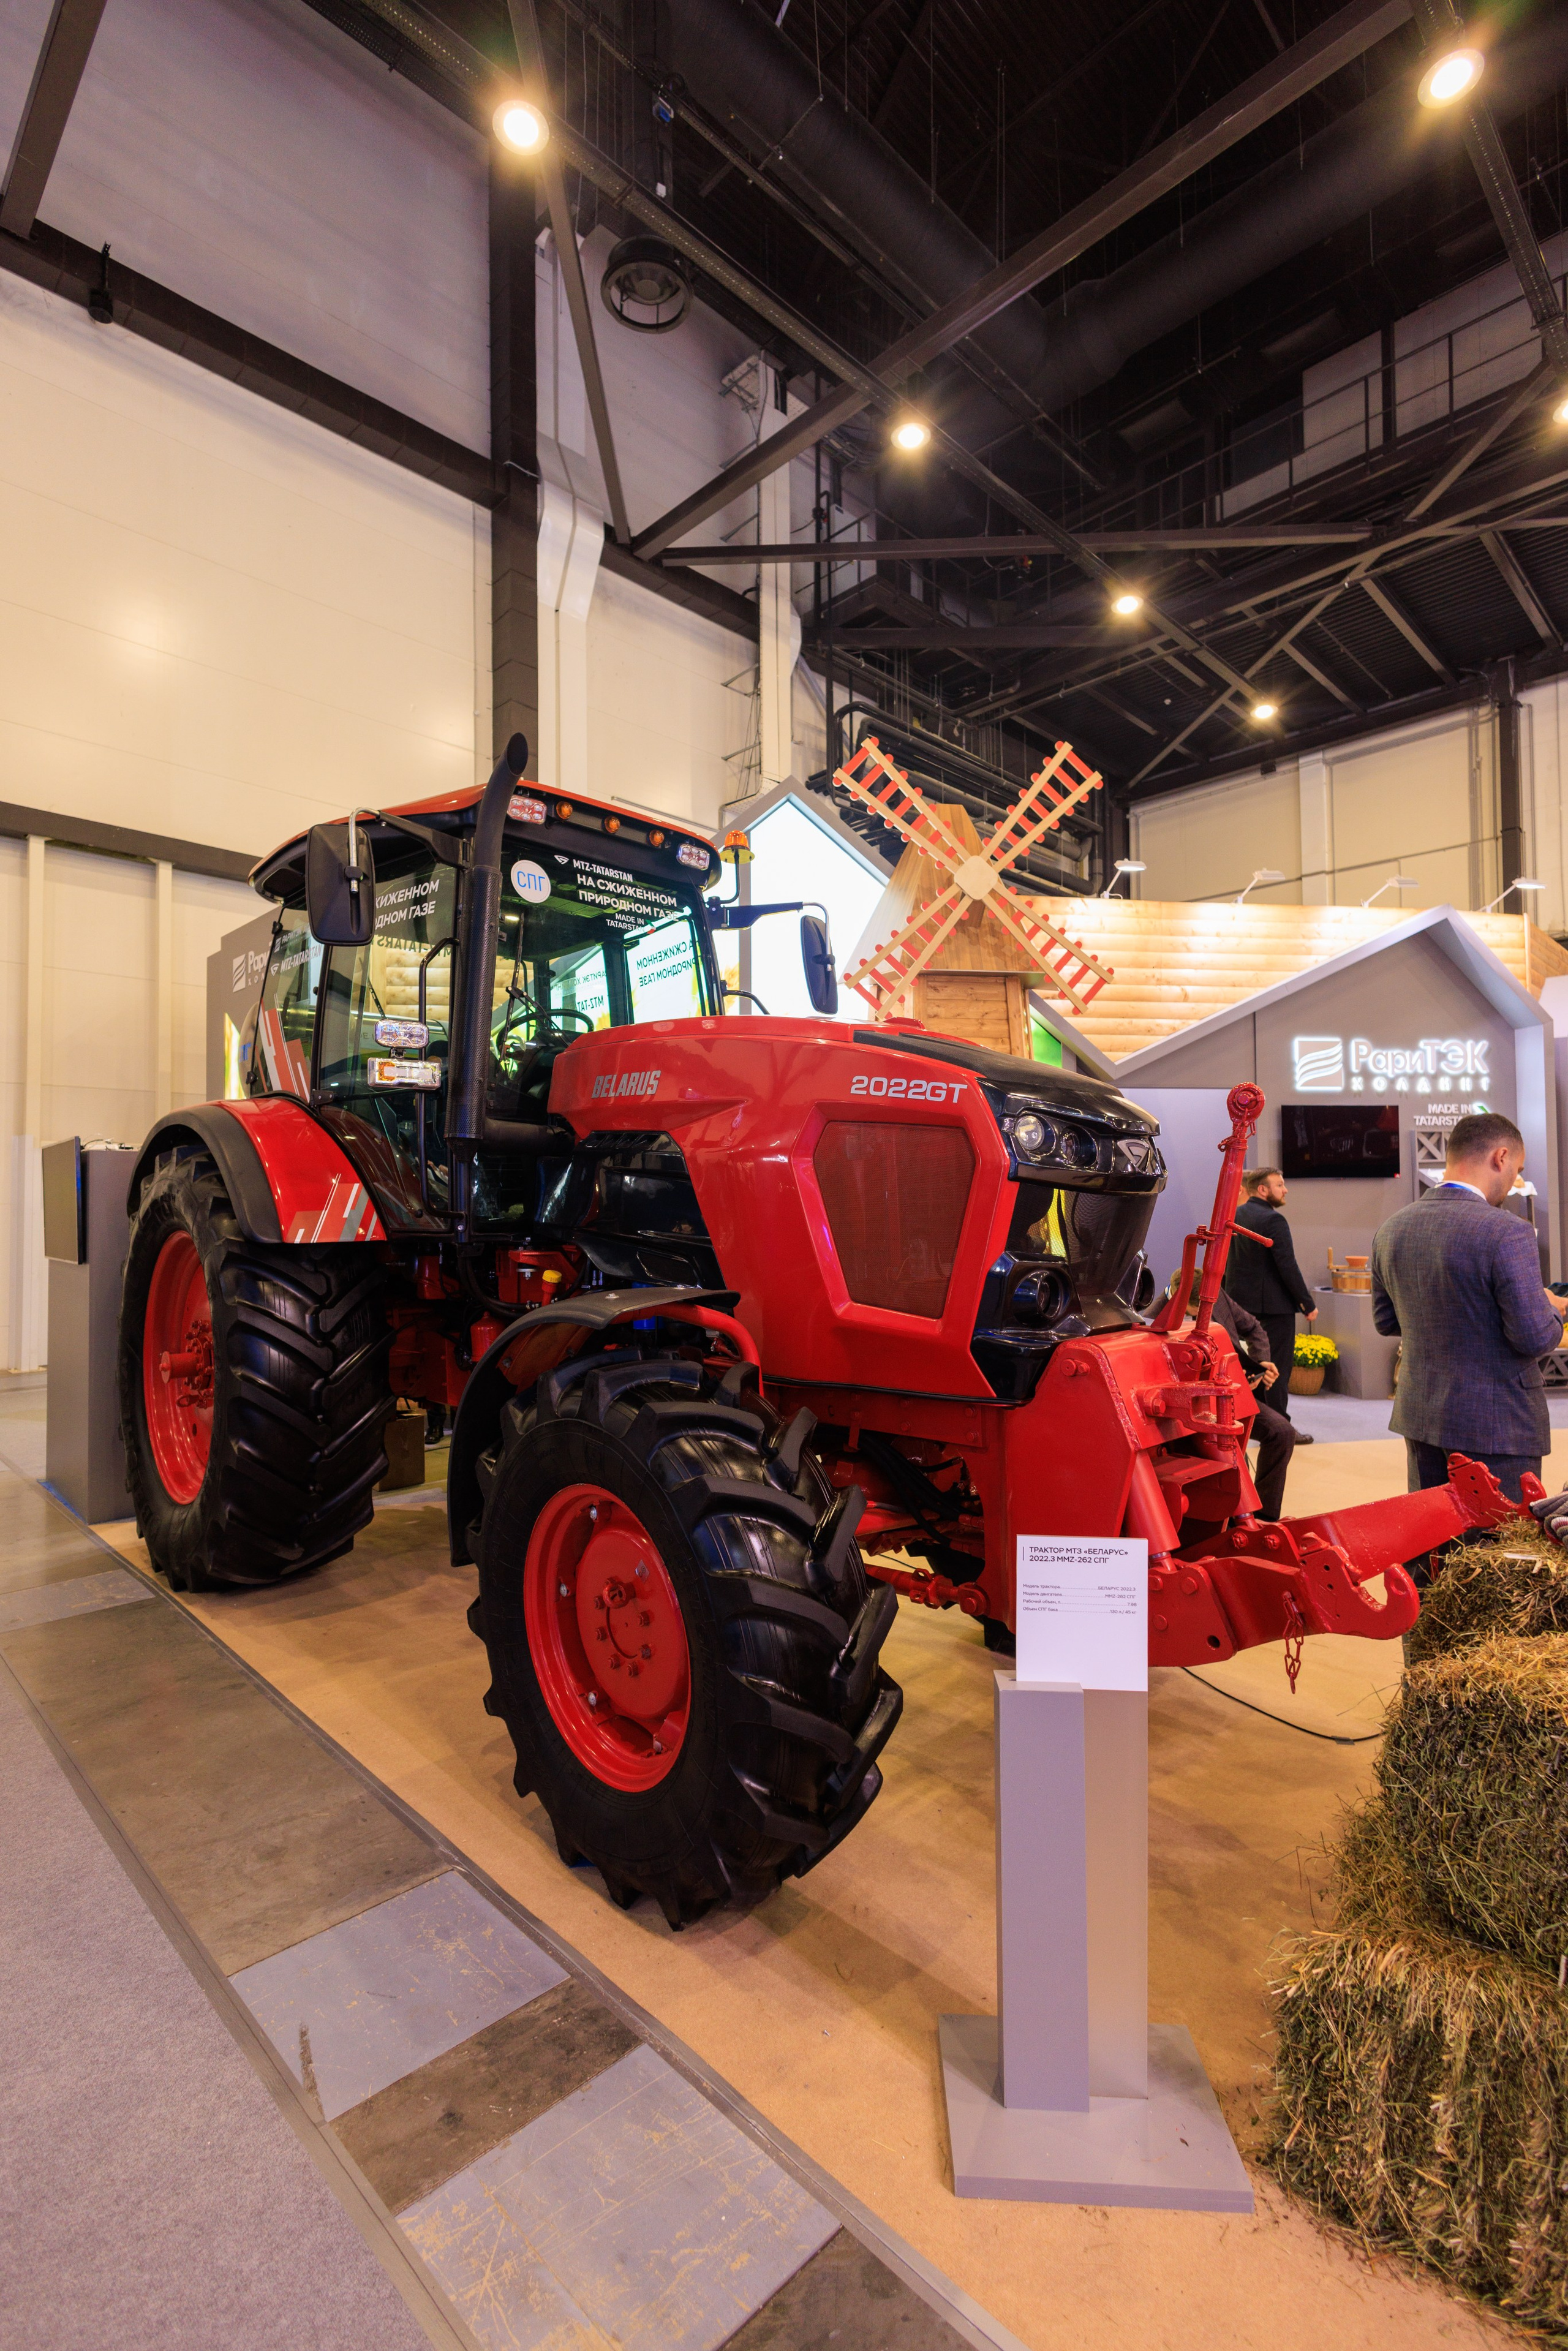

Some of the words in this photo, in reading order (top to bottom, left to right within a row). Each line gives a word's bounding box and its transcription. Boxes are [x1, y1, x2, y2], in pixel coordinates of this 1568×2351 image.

[517, 870, 545, 891] СПГ
[573, 859, 633, 883] MTZ-TATARSTAN
[577, 874, 596, 888] НА
[597, 879, 677, 907] СЖИЖЕННОМ
[409, 900, 436, 919] ГАЗЕ
[579, 890, 652, 916] ПРИРОДНОМ
[654, 908, 679, 921] ГАЗЕ
[606, 919, 645, 932] TATARSTAN
[616, 913, 636, 924] MADE
[280, 944, 322, 973] MTZ-TATARSTAN
[1352, 1040, 1490, 1077] РариТЭК
[591, 1070, 661, 1099] BELARUS
[850, 1076, 968, 1103] 2022GT
[1414, 1115, 1463, 1126] TATARST
[1428, 1104, 1458, 1114] MADE
[1461, 1104, 1472, 1114] IN
